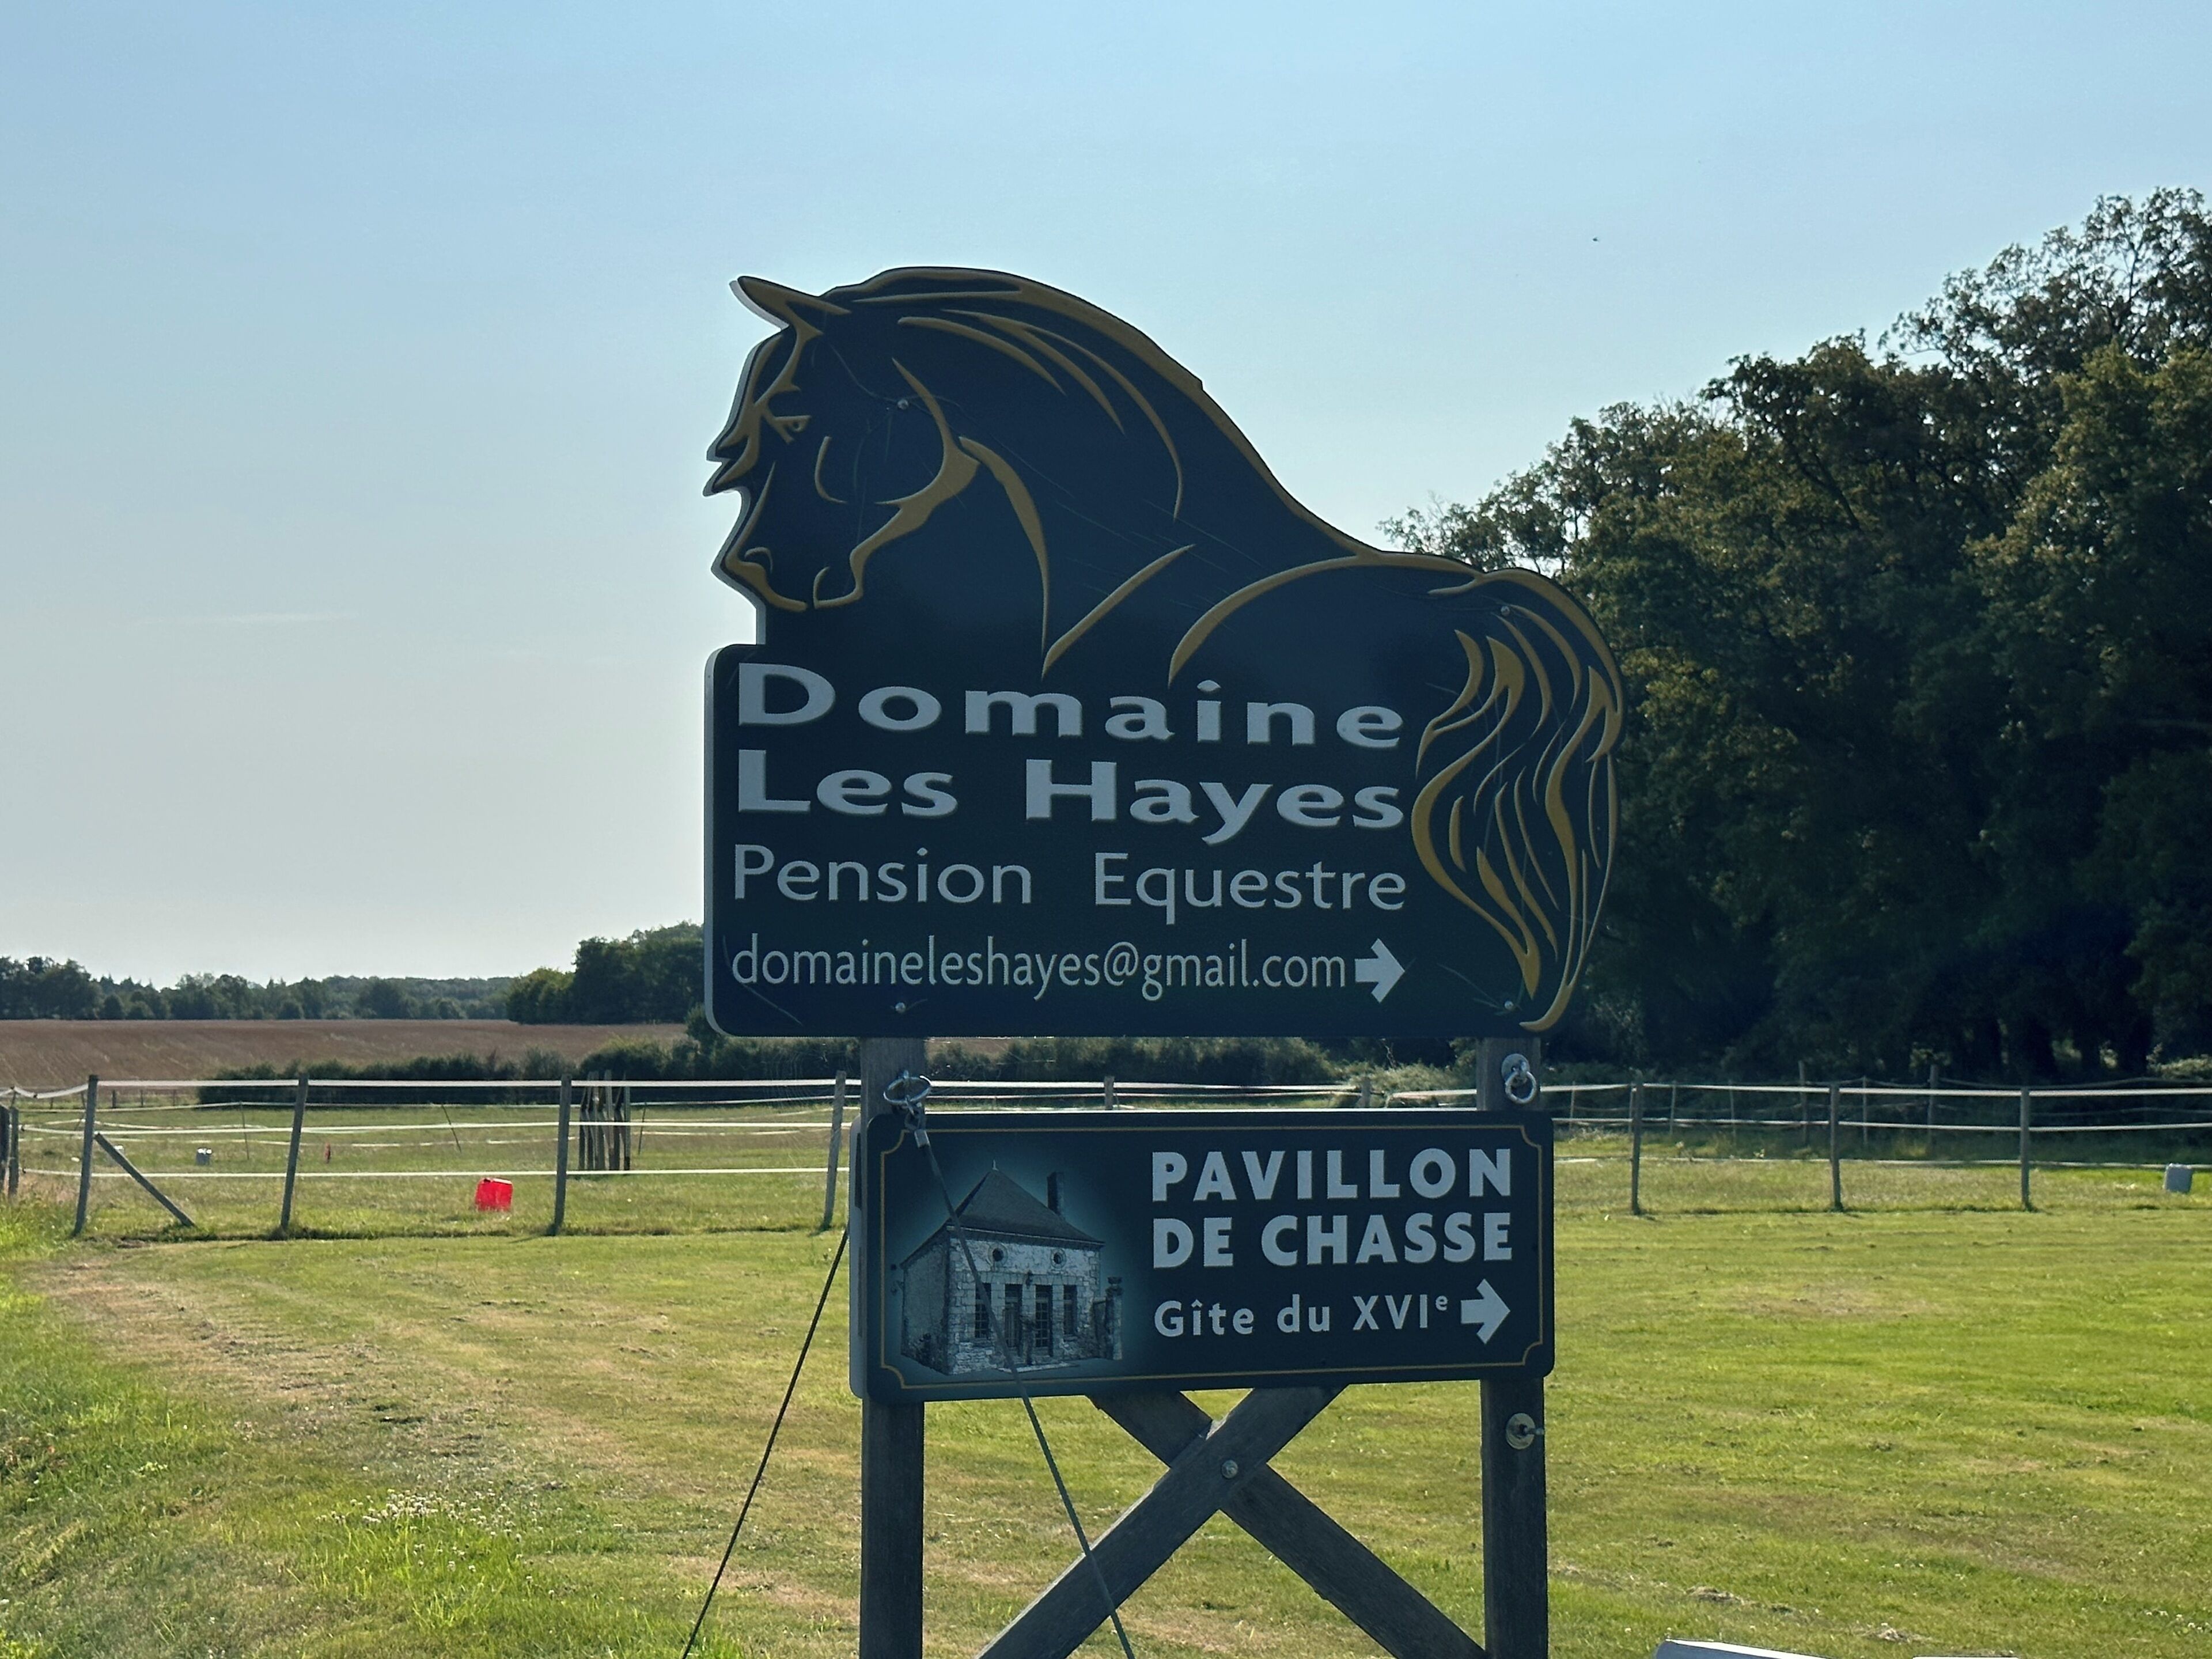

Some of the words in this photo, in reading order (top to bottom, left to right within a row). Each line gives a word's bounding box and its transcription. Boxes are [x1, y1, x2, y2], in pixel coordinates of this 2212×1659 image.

[737, 662, 1404, 749] Domaine
[737, 748, 958, 817] Les
[1025, 759, 1404, 845] Hayes
[734, 843, 1031, 904] Pension
[1094, 853, 1406, 925] Equestre
[732, 933, 1346, 1001] domaineleshayes@gmail.com
[1151, 1148, 1512, 1202] PAVILLON
[1152, 1216, 1234, 1270] DE
[1261, 1211, 1513, 1266] CHASSE
[1154, 1298, 1255, 1338] Gîte
[1277, 1293, 1331, 1334] du
